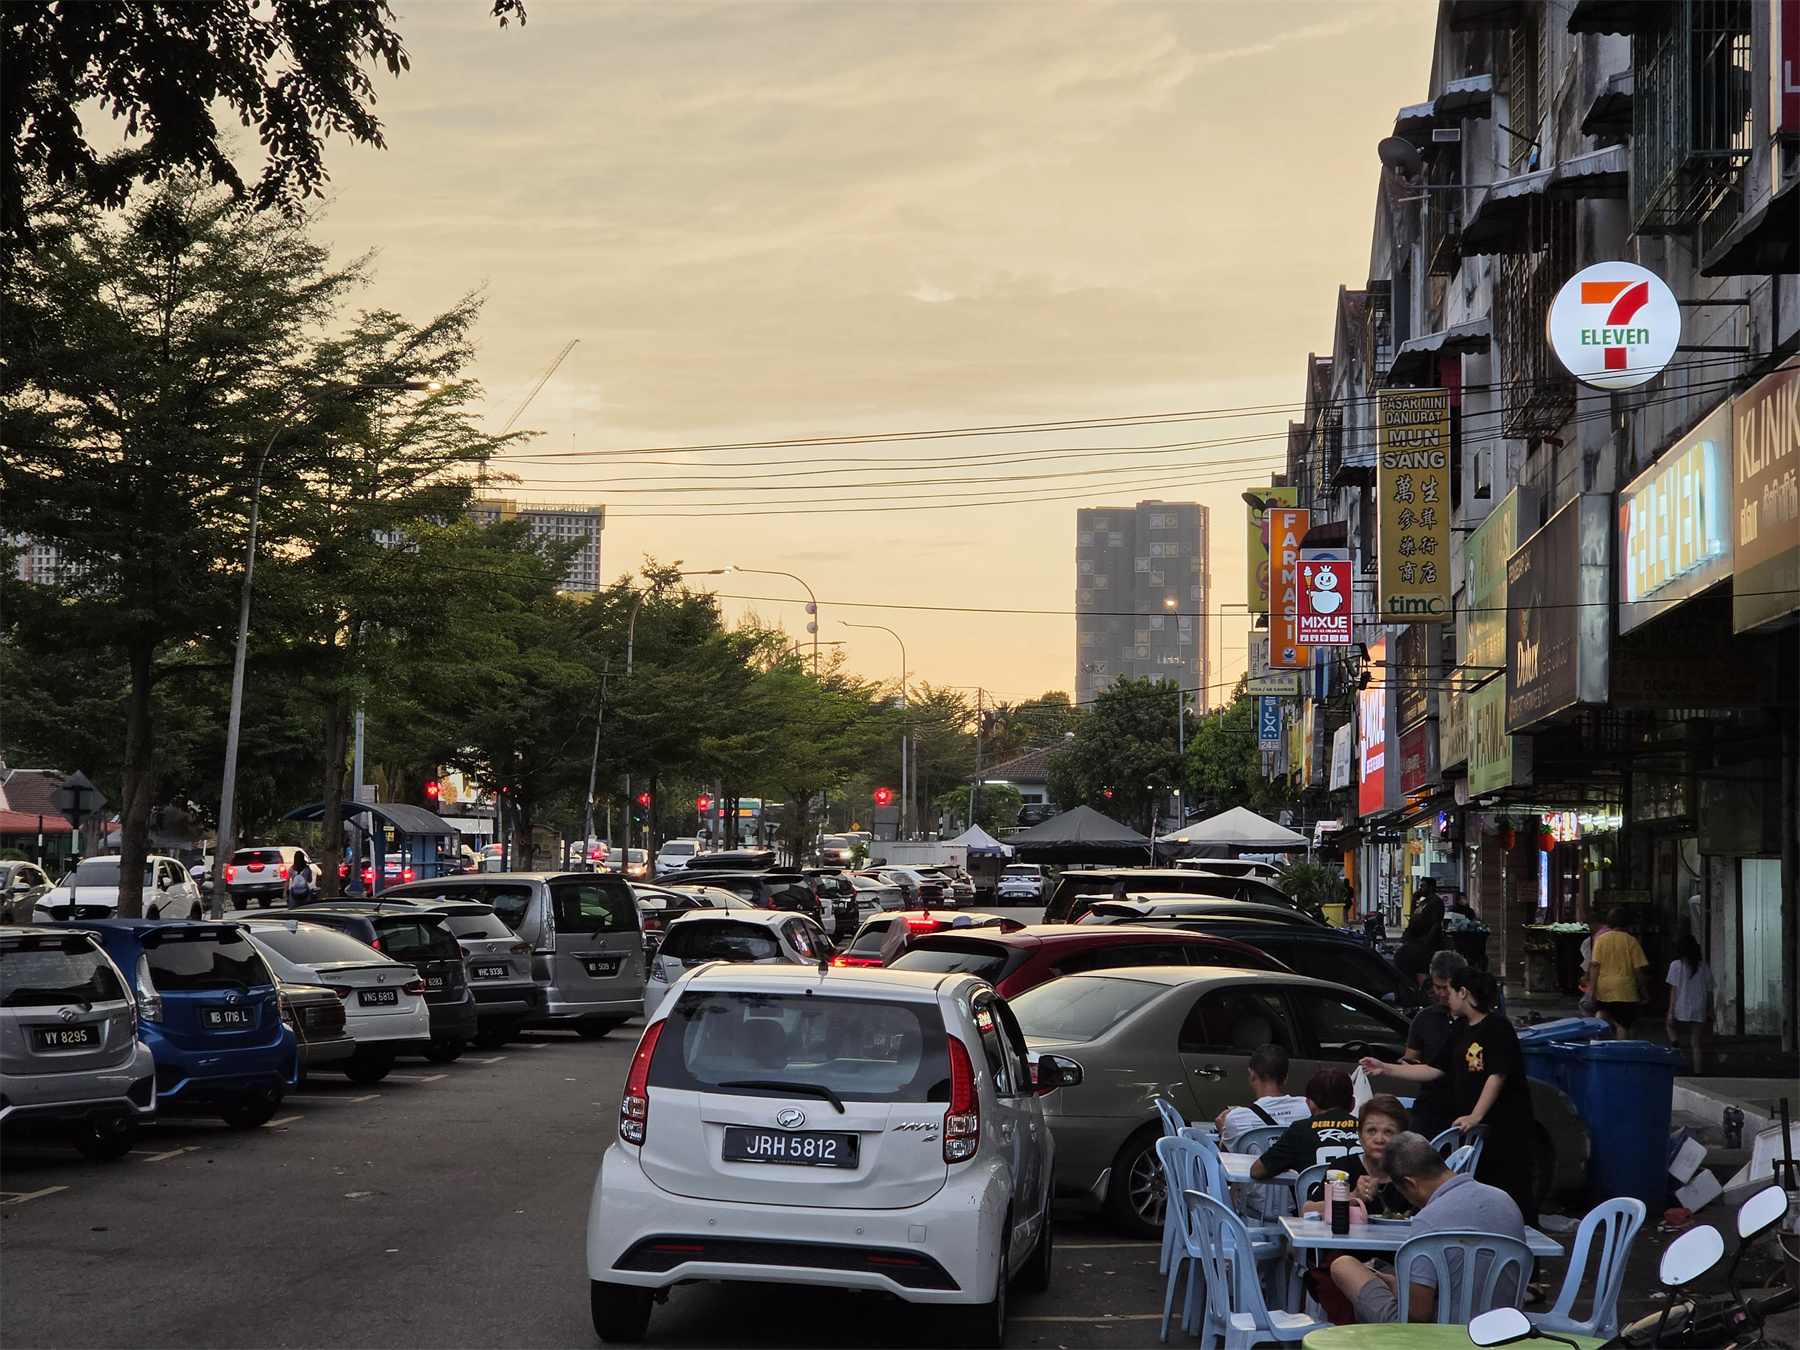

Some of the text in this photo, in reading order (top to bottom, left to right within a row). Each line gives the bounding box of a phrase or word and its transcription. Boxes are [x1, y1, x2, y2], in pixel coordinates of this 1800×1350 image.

[1581, 281, 1649, 369] 7
[1381, 396, 1446, 410] PASAR MINI
[1386, 411, 1409, 424] DAN
[1740, 379, 1800, 483] KLINIK
[1389, 430, 1439, 447] MUN
[1383, 451, 1445, 468] SANG
[1301, 616, 1347, 628] MIXUE
[1516, 639, 1539, 688] Dulux
[363, 991, 394, 1002] VNS 6813
[224, 1011, 240, 1022] 1716
[241, 1011, 248, 1021] L
[45, 1030, 87, 1044] VY 8295
[1336, 1120, 1354, 1128] FOR
[747, 1136, 836, 1159] JRH 5812
